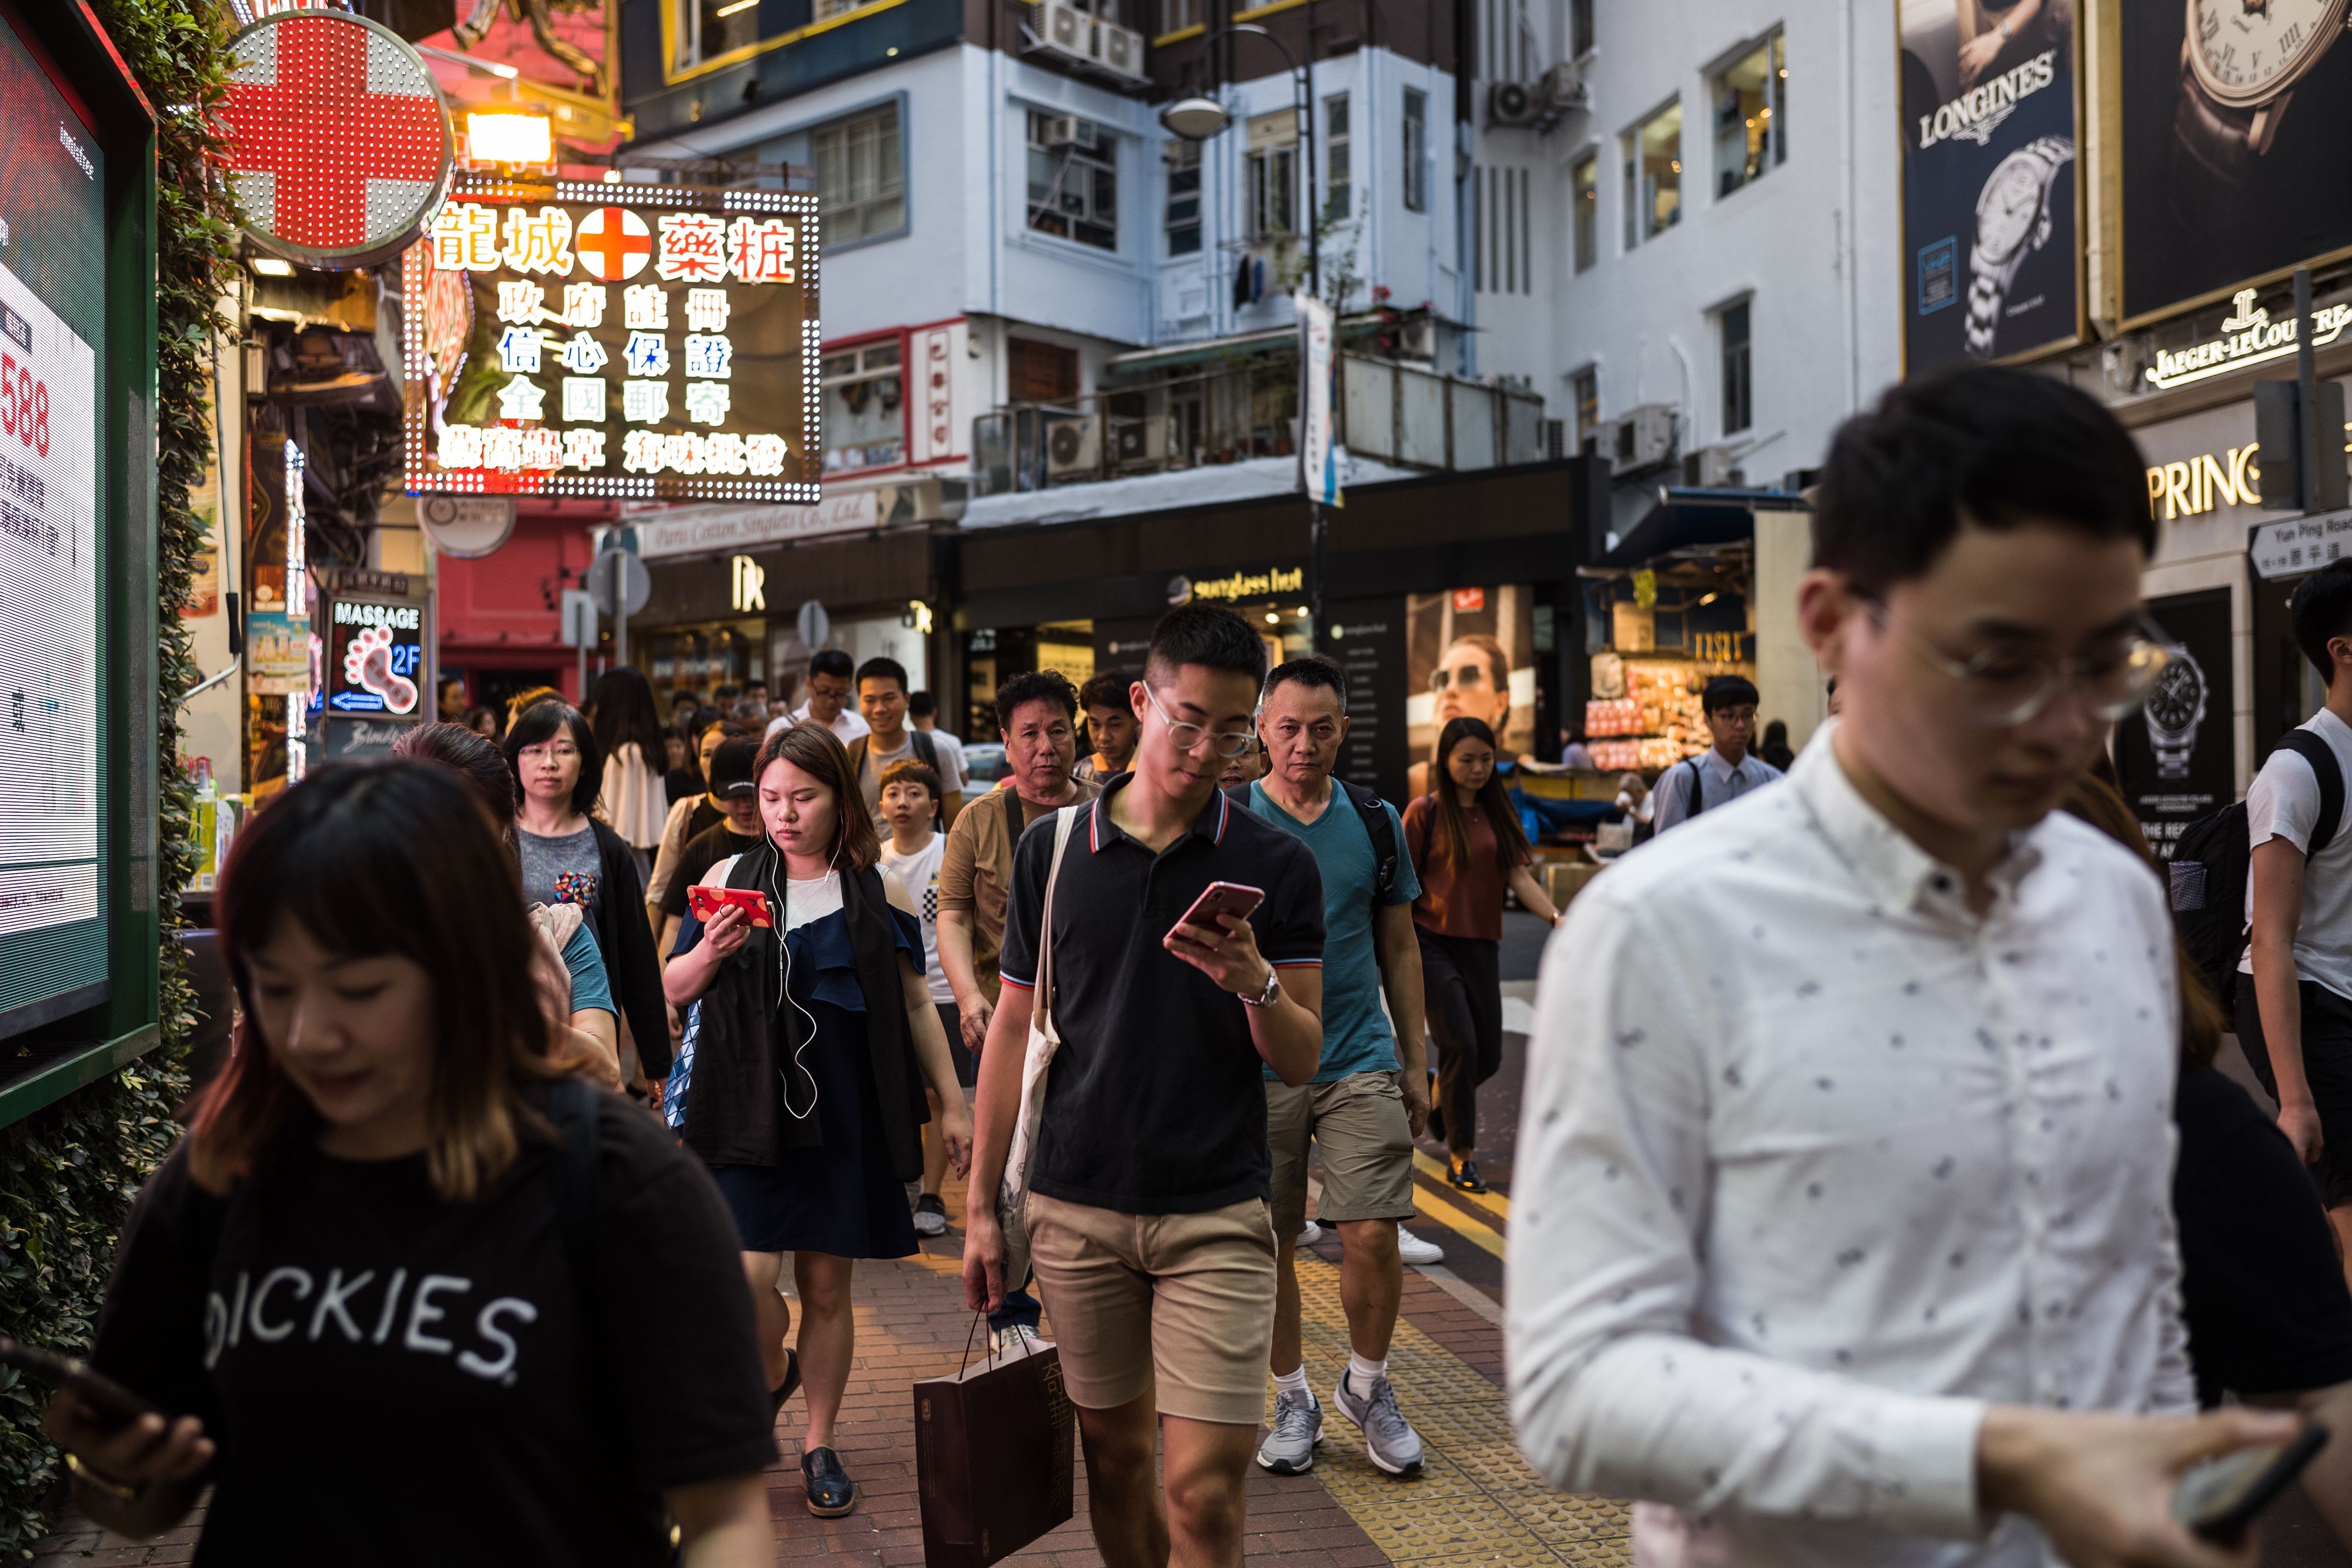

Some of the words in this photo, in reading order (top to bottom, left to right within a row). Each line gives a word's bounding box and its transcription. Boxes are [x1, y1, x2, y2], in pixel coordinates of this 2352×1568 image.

[1919, 53, 2056, 149] LONGINES
[430, 202, 574, 278] 龍城
[656, 213, 797, 284] 藥粧
[496, 279, 730, 332] 政府註冊
[496, 326, 733, 379] 信心保證
[2146, 303, 2350, 383] JAEGER-LECOURE
[2, 352, 49, 458] 588
[496, 373, 730, 426] 全國郵寄
[691, 521, 738, 543] Cotton
[739, 510, 795, 540] Singlets
[2274, 528, 2296, 543] Yun
[2298, 523, 2323, 539] Ping
[335, 602, 419, 630] MASSAGE
[392, 644, 420, 675] 2F
[204, 1266, 538, 1380] DICKIES
